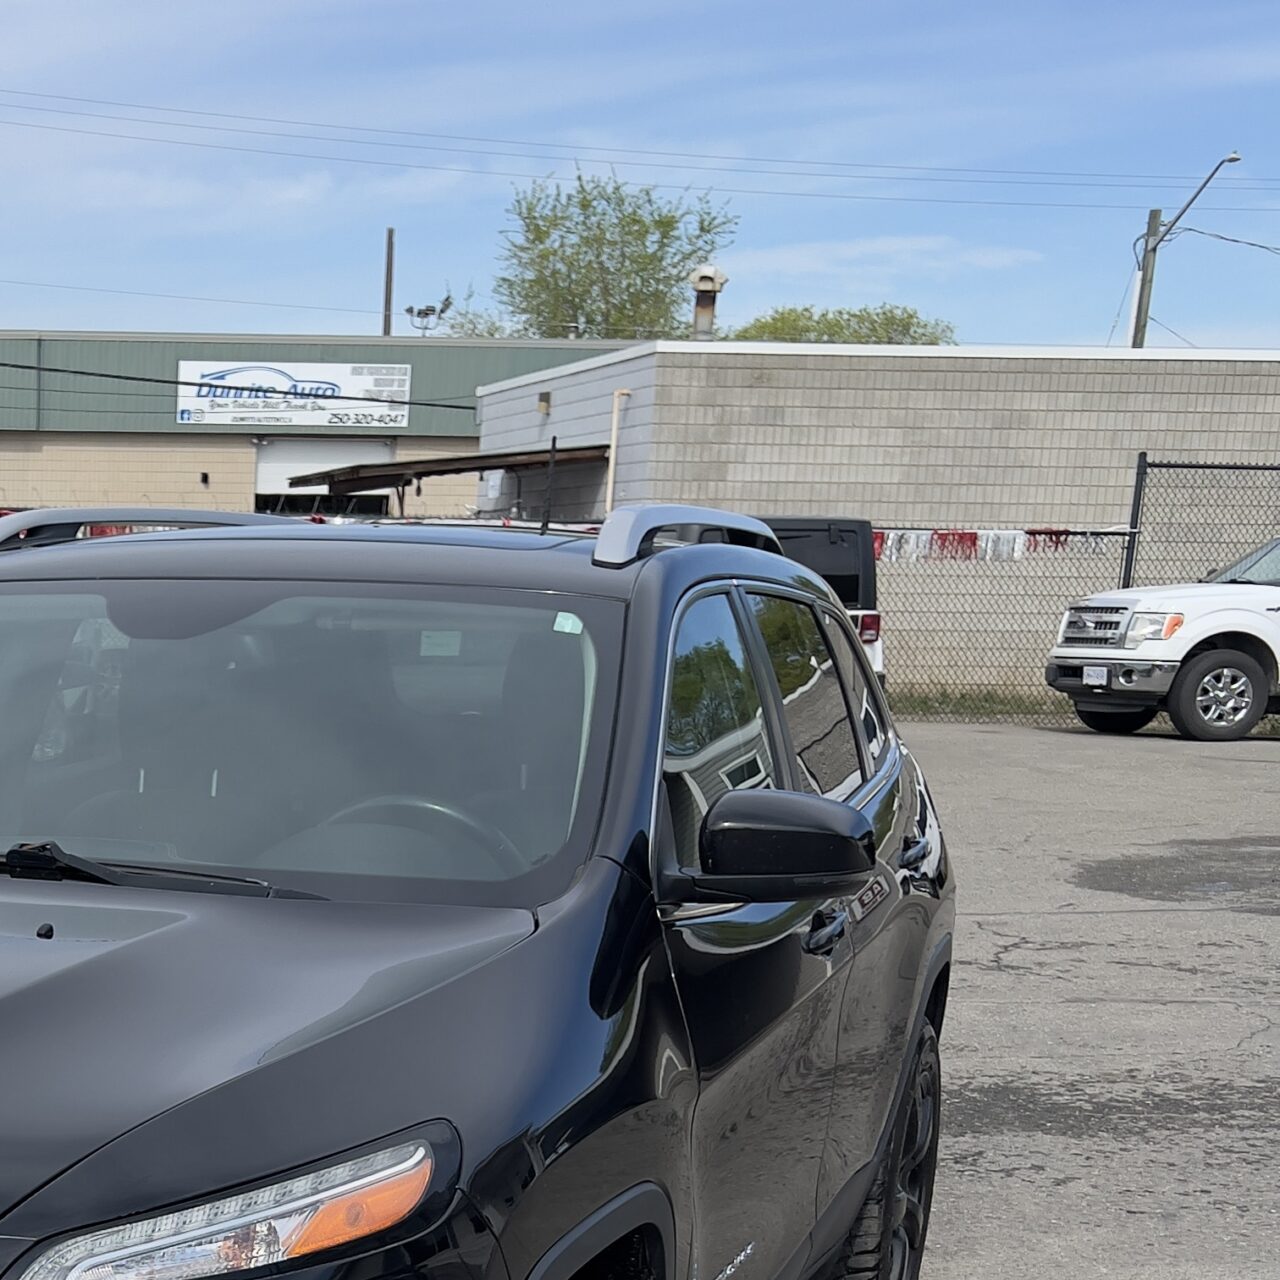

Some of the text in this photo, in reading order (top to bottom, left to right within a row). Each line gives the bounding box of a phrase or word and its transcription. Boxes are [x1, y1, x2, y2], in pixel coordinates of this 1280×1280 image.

[197, 383, 336, 399] Dunrite Auto
[328, 413, 405, 425] 250-320-4047
